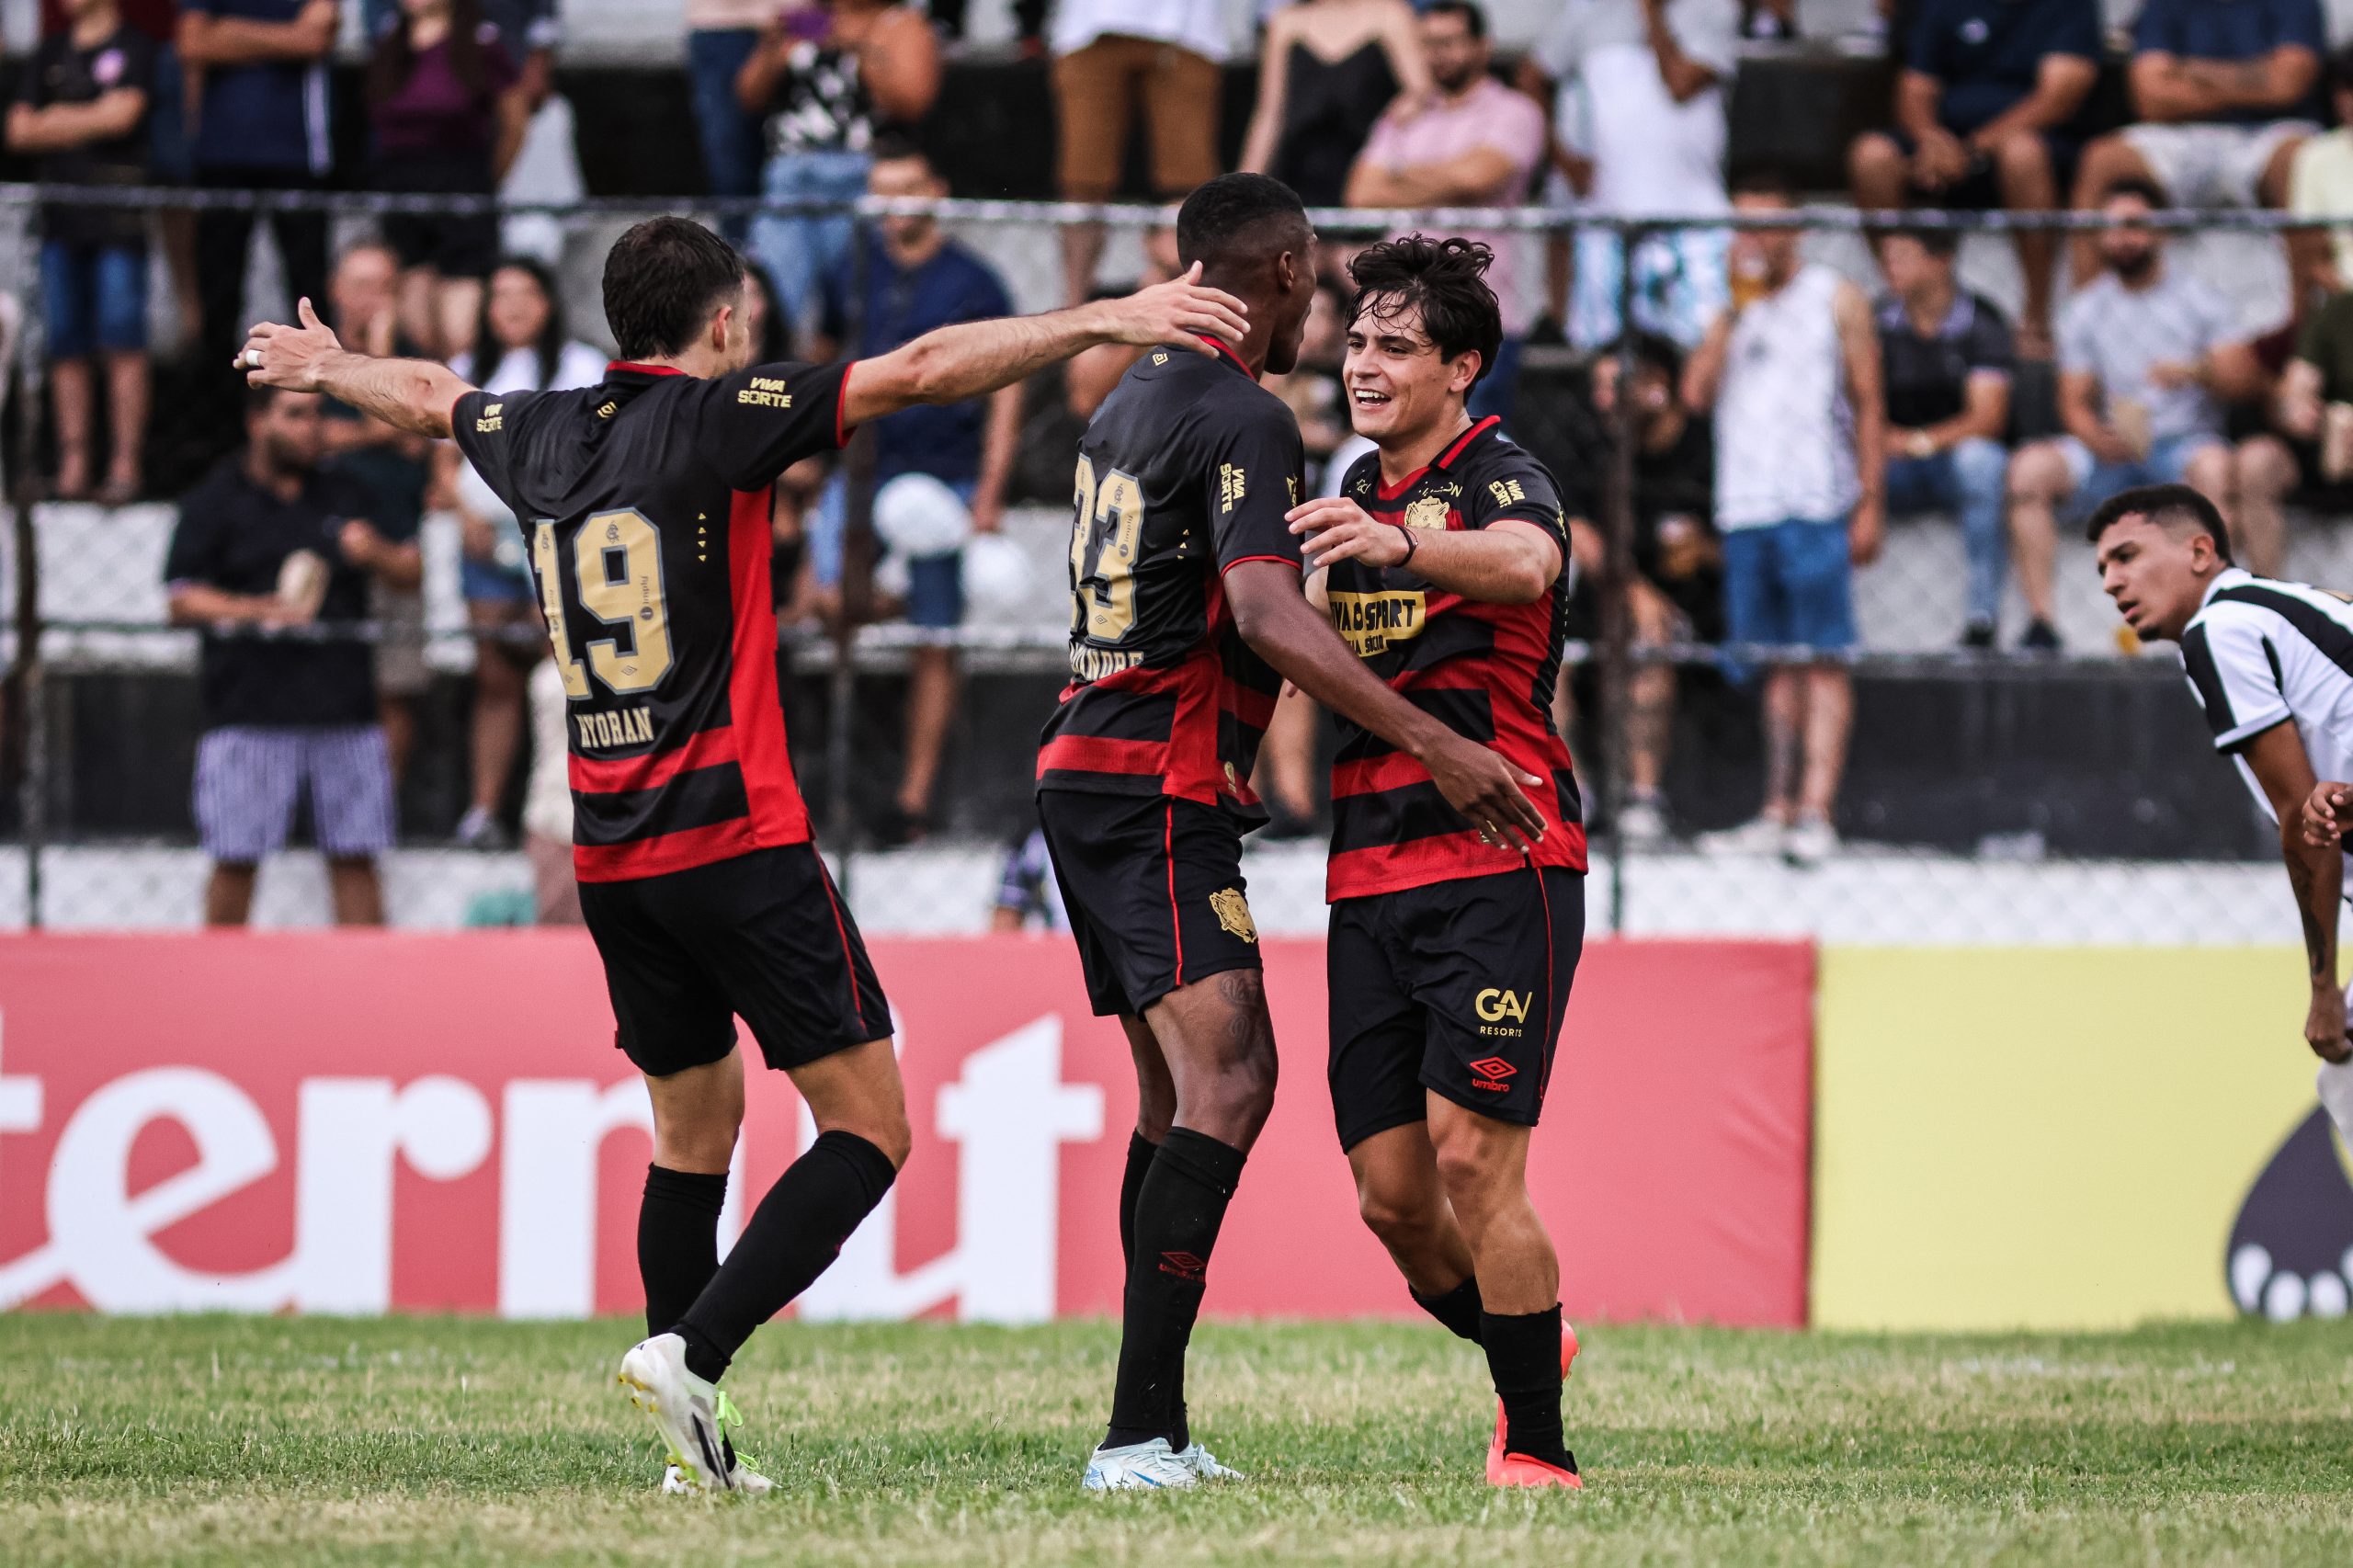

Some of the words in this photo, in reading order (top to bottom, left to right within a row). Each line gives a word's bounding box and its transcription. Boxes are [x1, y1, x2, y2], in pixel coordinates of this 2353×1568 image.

[738, 390, 792, 408] SORTE
[750, 377, 786, 392] VIVA
[1220, 463, 1233, 514] SORTE
[1233, 469, 1245, 500] VIVA
[533, 507, 675, 700] 19
[1354, 602, 1363, 631] O
[1365, 599, 1416, 631] SPORT
[1475, 988, 1533, 1024] GAV
[1480, 1026, 1522, 1038] RESORTS
[1472, 1077, 1510, 1093] umbro
